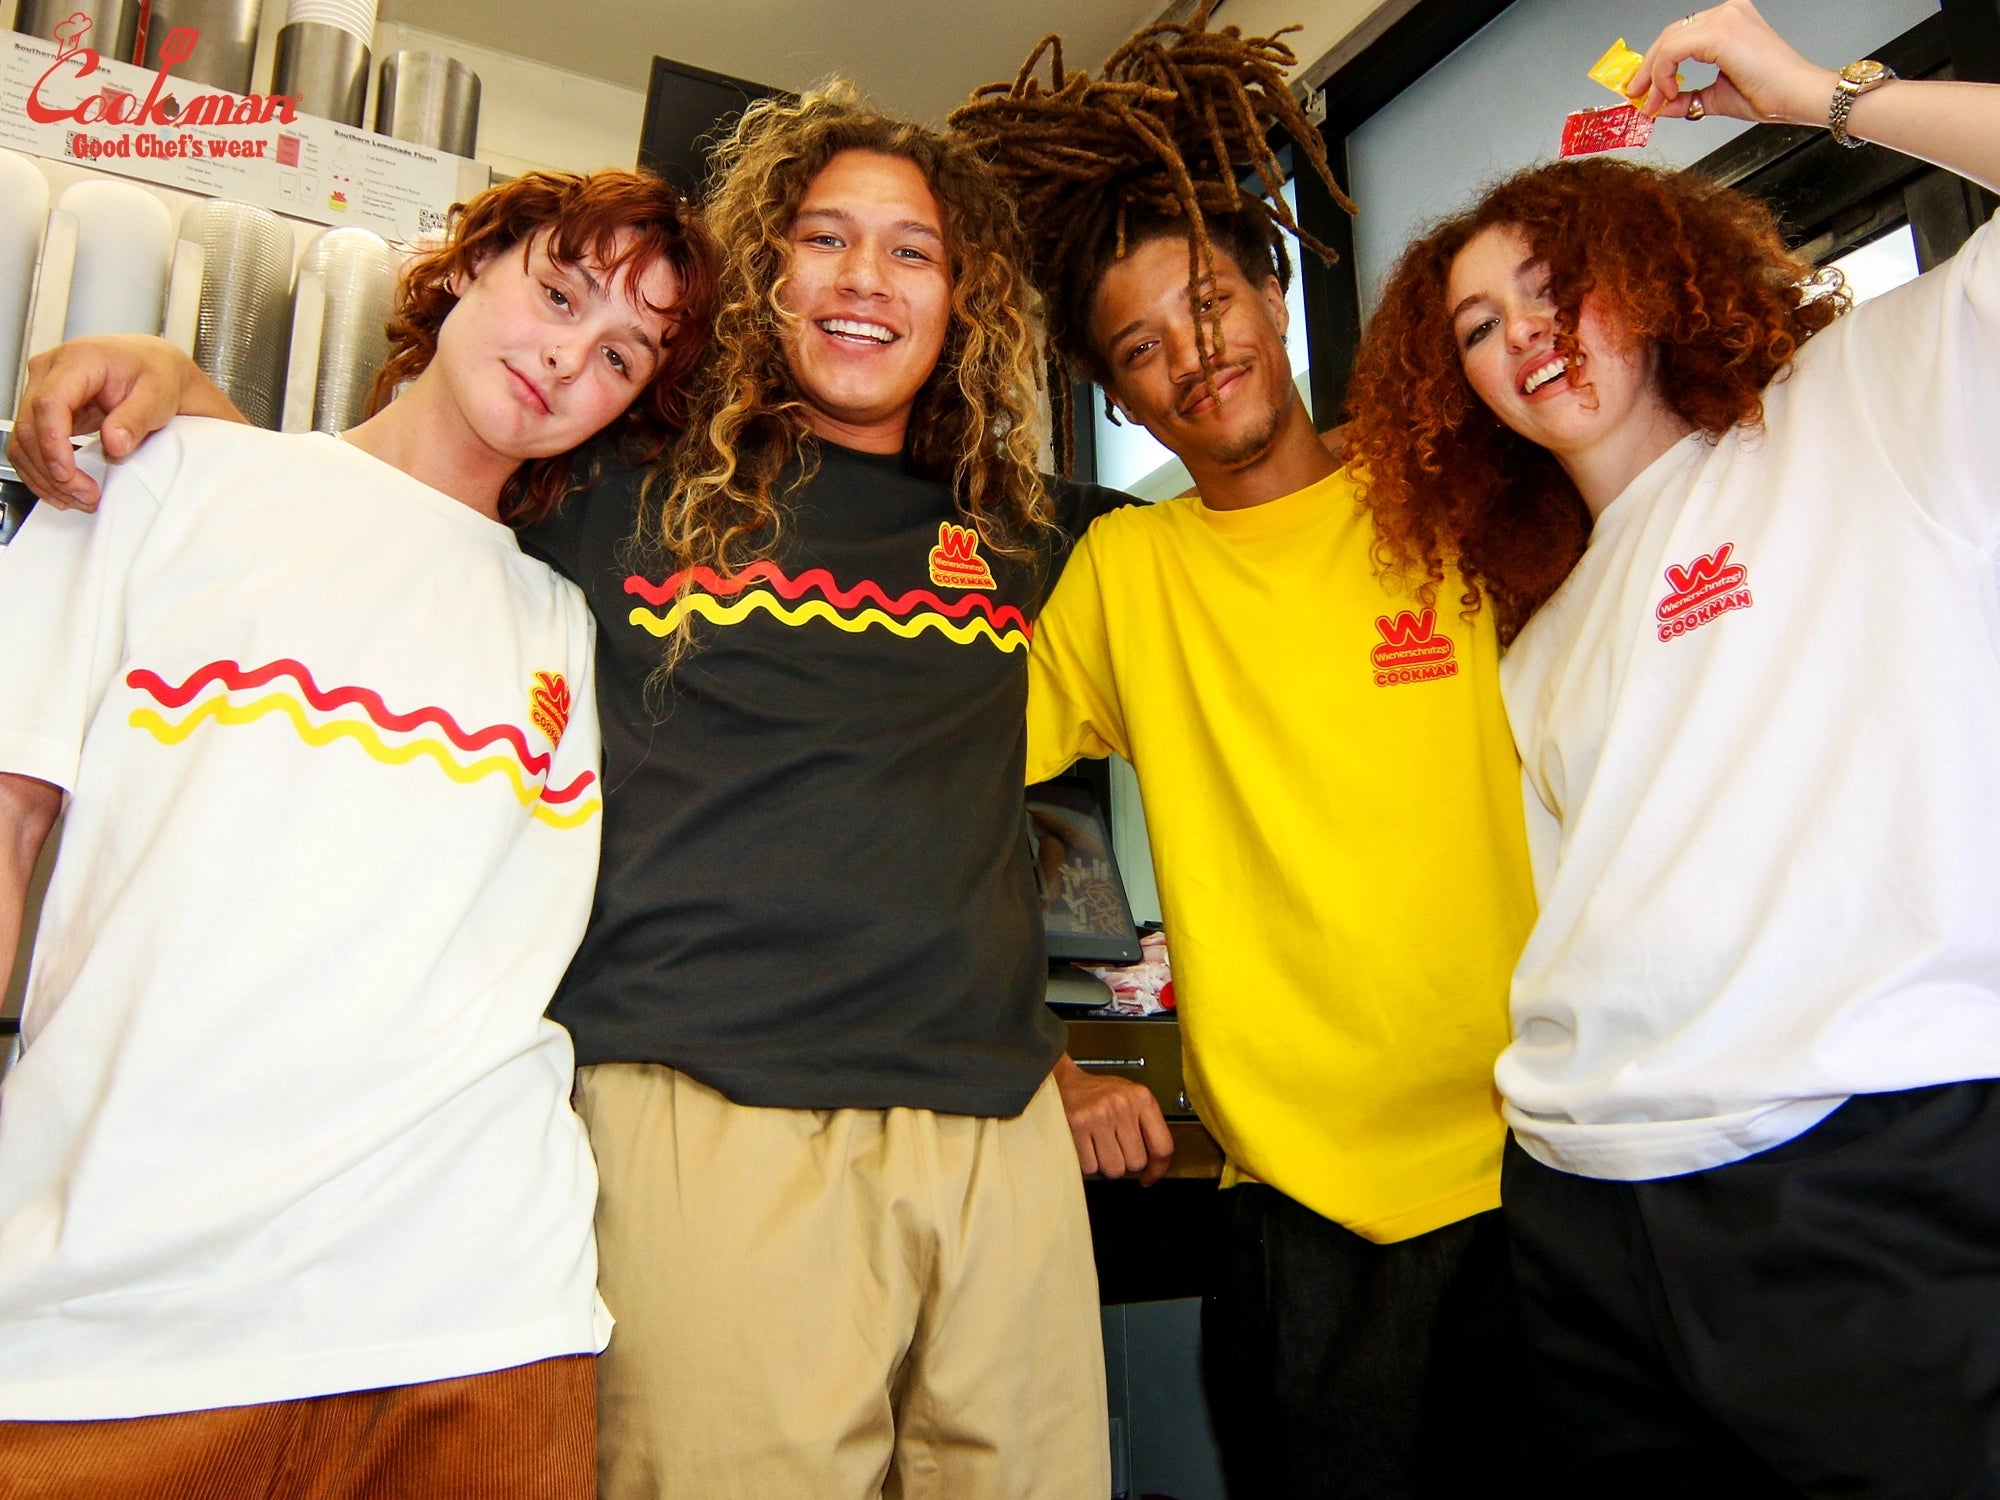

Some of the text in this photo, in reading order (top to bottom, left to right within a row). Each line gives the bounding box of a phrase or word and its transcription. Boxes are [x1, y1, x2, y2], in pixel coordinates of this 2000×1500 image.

[334, 129, 370, 145] Southern
[372, 140, 412, 156] Lemonade
[414, 150, 438, 163] Floats
[934, 574, 992, 586] COOKMAN
[1660, 571, 1742, 615] Wienerschnitzel
[1375, 608, 1436, 647] W
[1659, 590, 1751, 641] COOKMAN
[1375, 643, 1450, 663] Wienerschnitzel
[1375, 662, 1457, 686] COOKMAN
